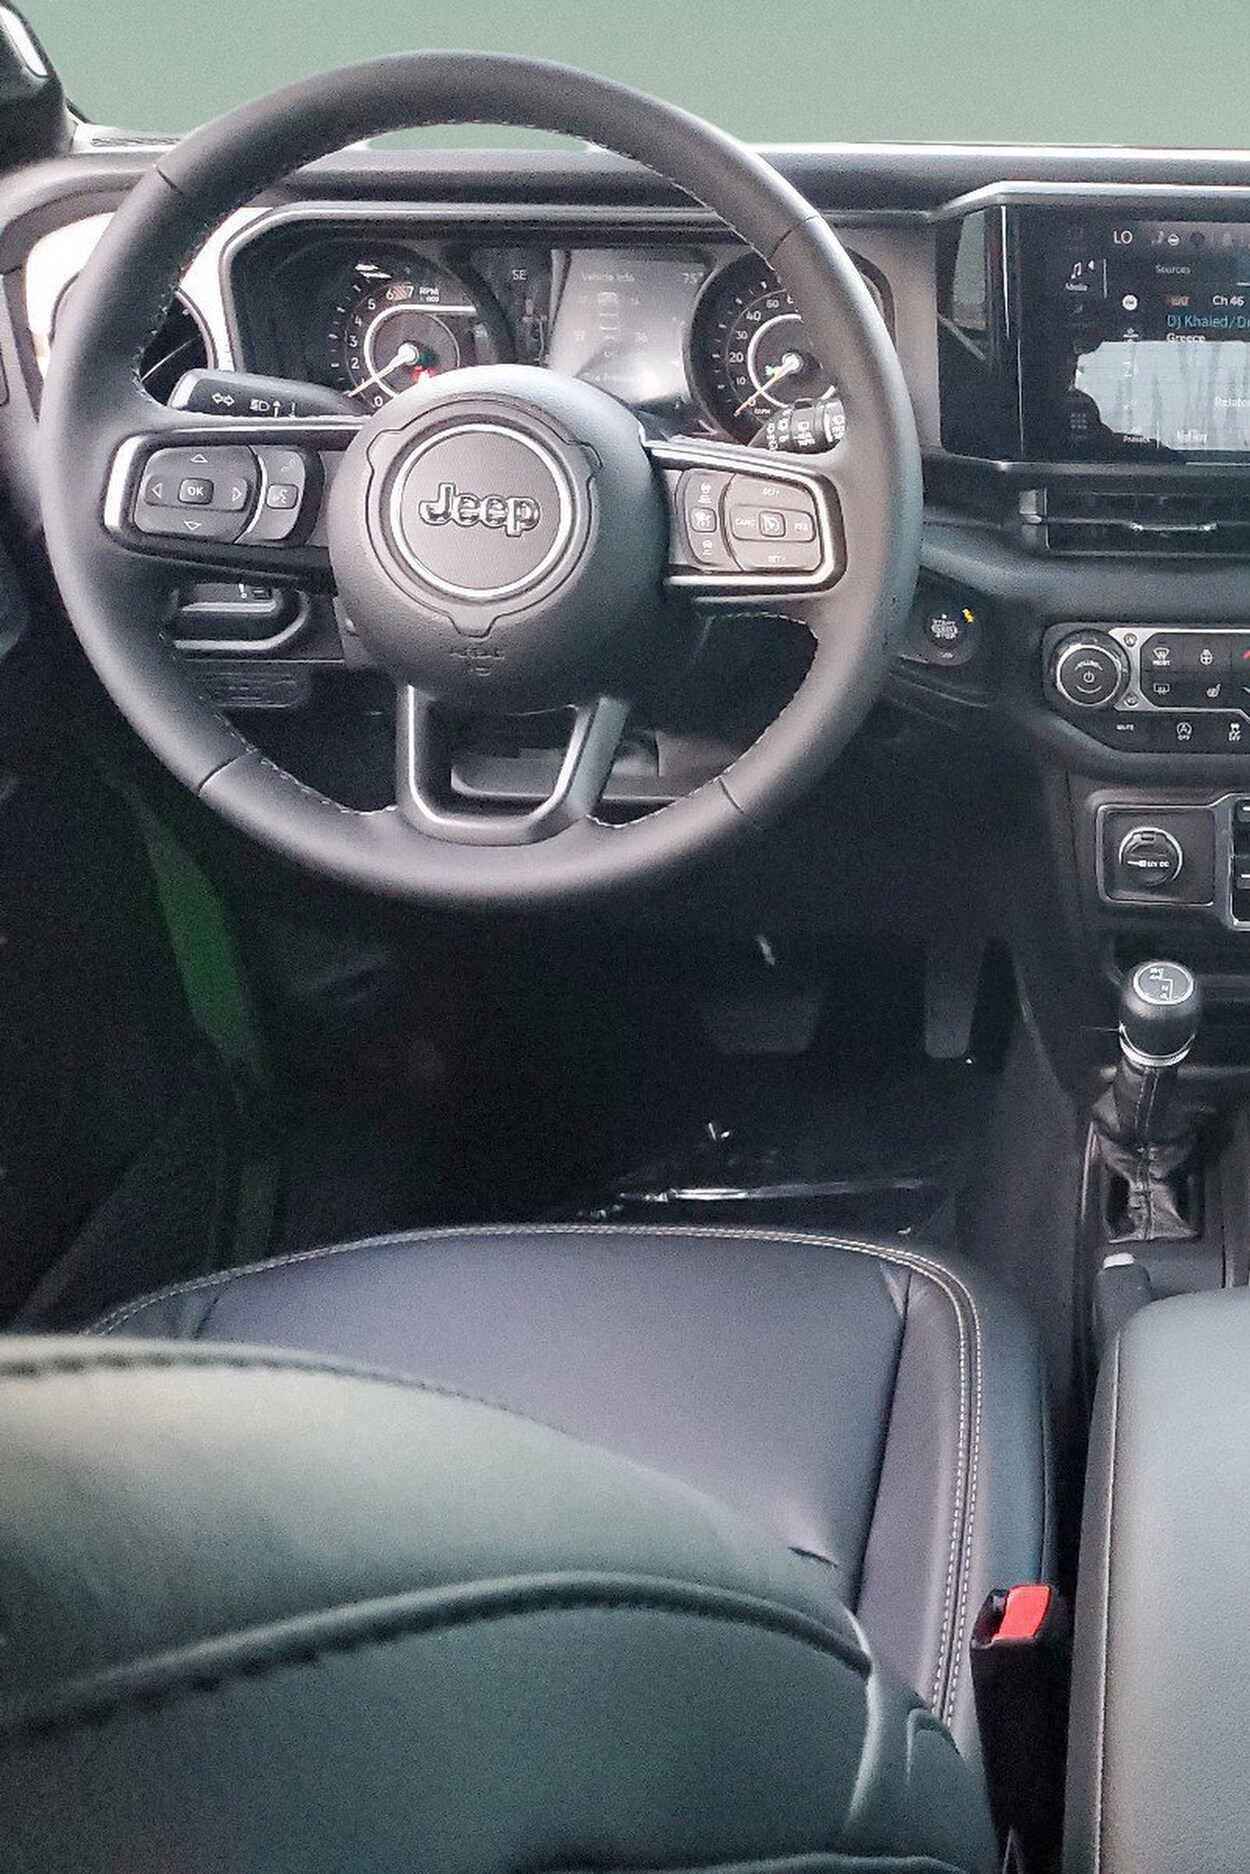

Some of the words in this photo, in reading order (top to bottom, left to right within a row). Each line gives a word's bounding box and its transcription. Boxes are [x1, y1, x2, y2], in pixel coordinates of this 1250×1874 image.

[1114, 231, 1133, 244] LO
[512, 269, 527, 280] SE
[1156, 264, 1190, 274] Sources
[367, 298, 376, 311] 5
[1212, 295, 1228, 307] Ch
[1229, 296, 1244, 307] 46
[746, 310, 761, 320] 40
[354, 316, 362, 326] 4
[735, 330, 748, 340] 30
[350, 335, 358, 348] 3
[729, 351, 744, 362] 20
[351, 357, 360, 369] 2
[736, 377, 746, 386] 10
[187, 486, 205, 497] OK
[418, 482, 542, 537] Jeep
